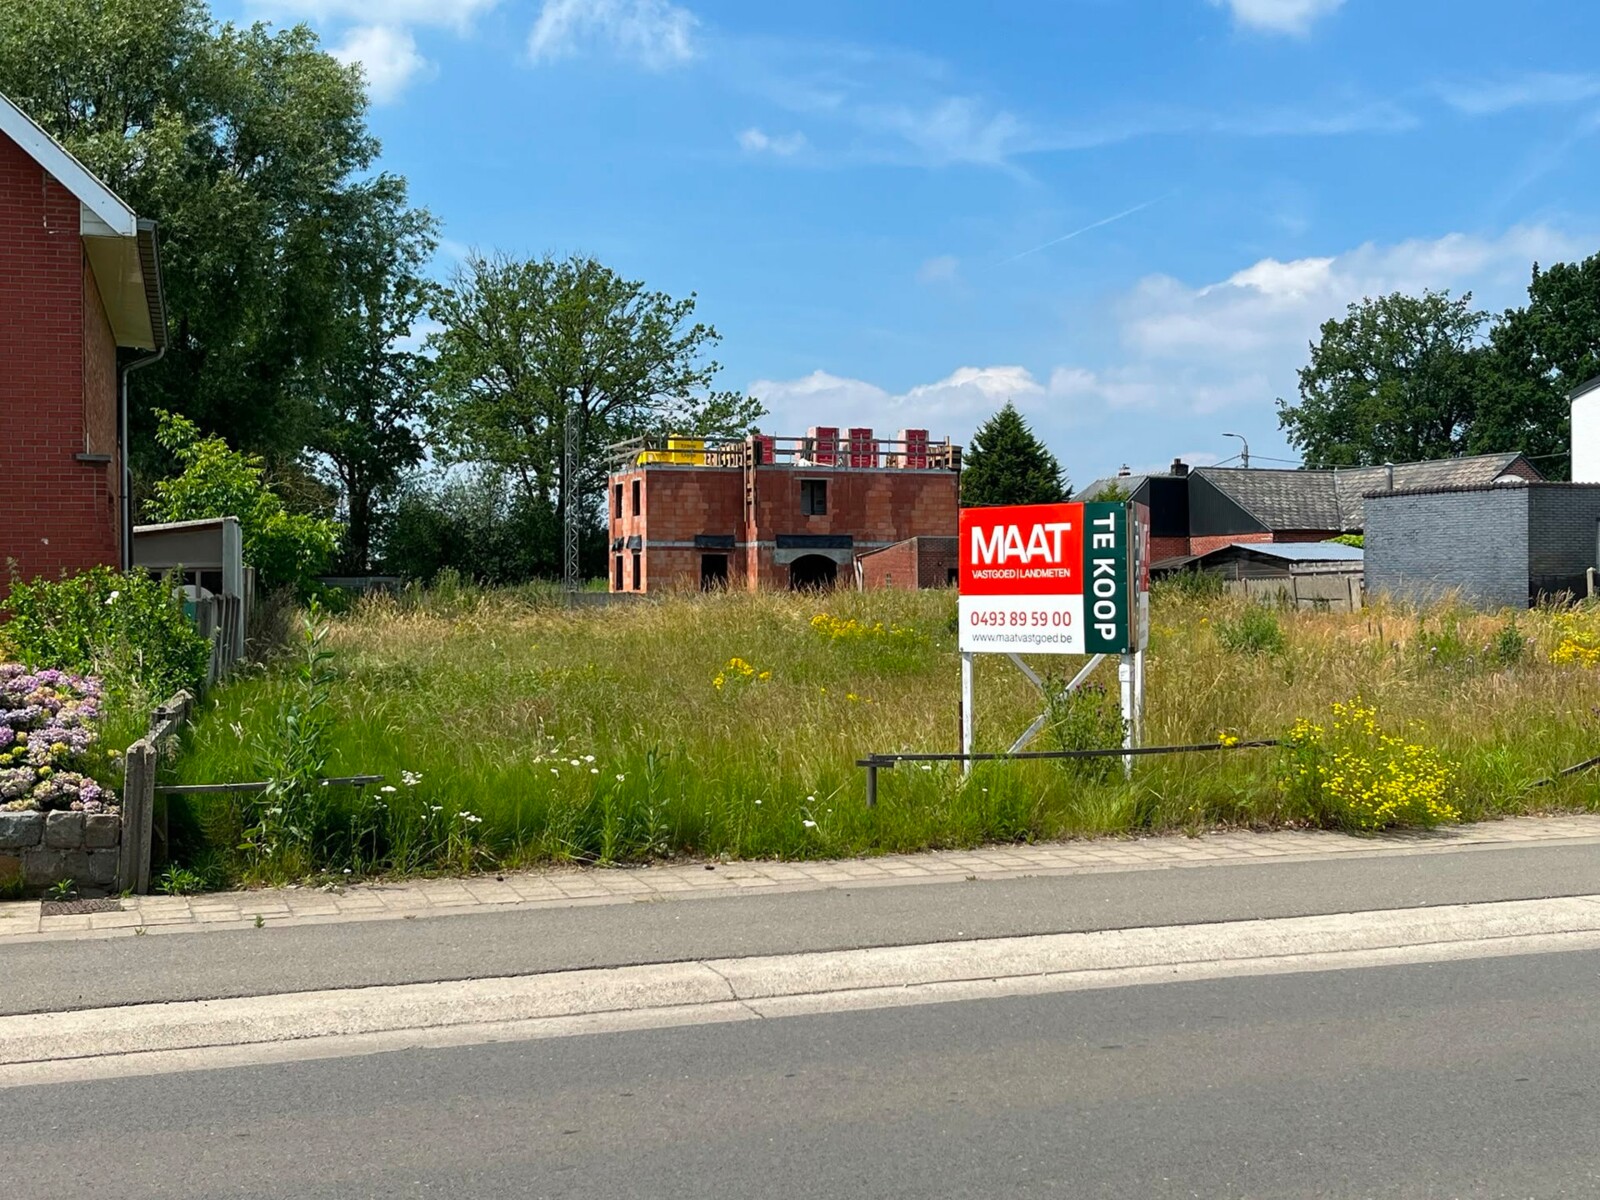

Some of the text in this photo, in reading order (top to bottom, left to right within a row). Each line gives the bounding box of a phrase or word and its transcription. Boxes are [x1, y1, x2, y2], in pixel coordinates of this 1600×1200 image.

[971, 522, 1071, 564] MAAT
[972, 568, 1070, 579] VASTGOED LANDMETEN
[1092, 512, 1116, 641] TE KOOP
[970, 611, 1072, 626] 0493 89 59 00
[972, 632, 1072, 645] www.maatvastgoed.be
